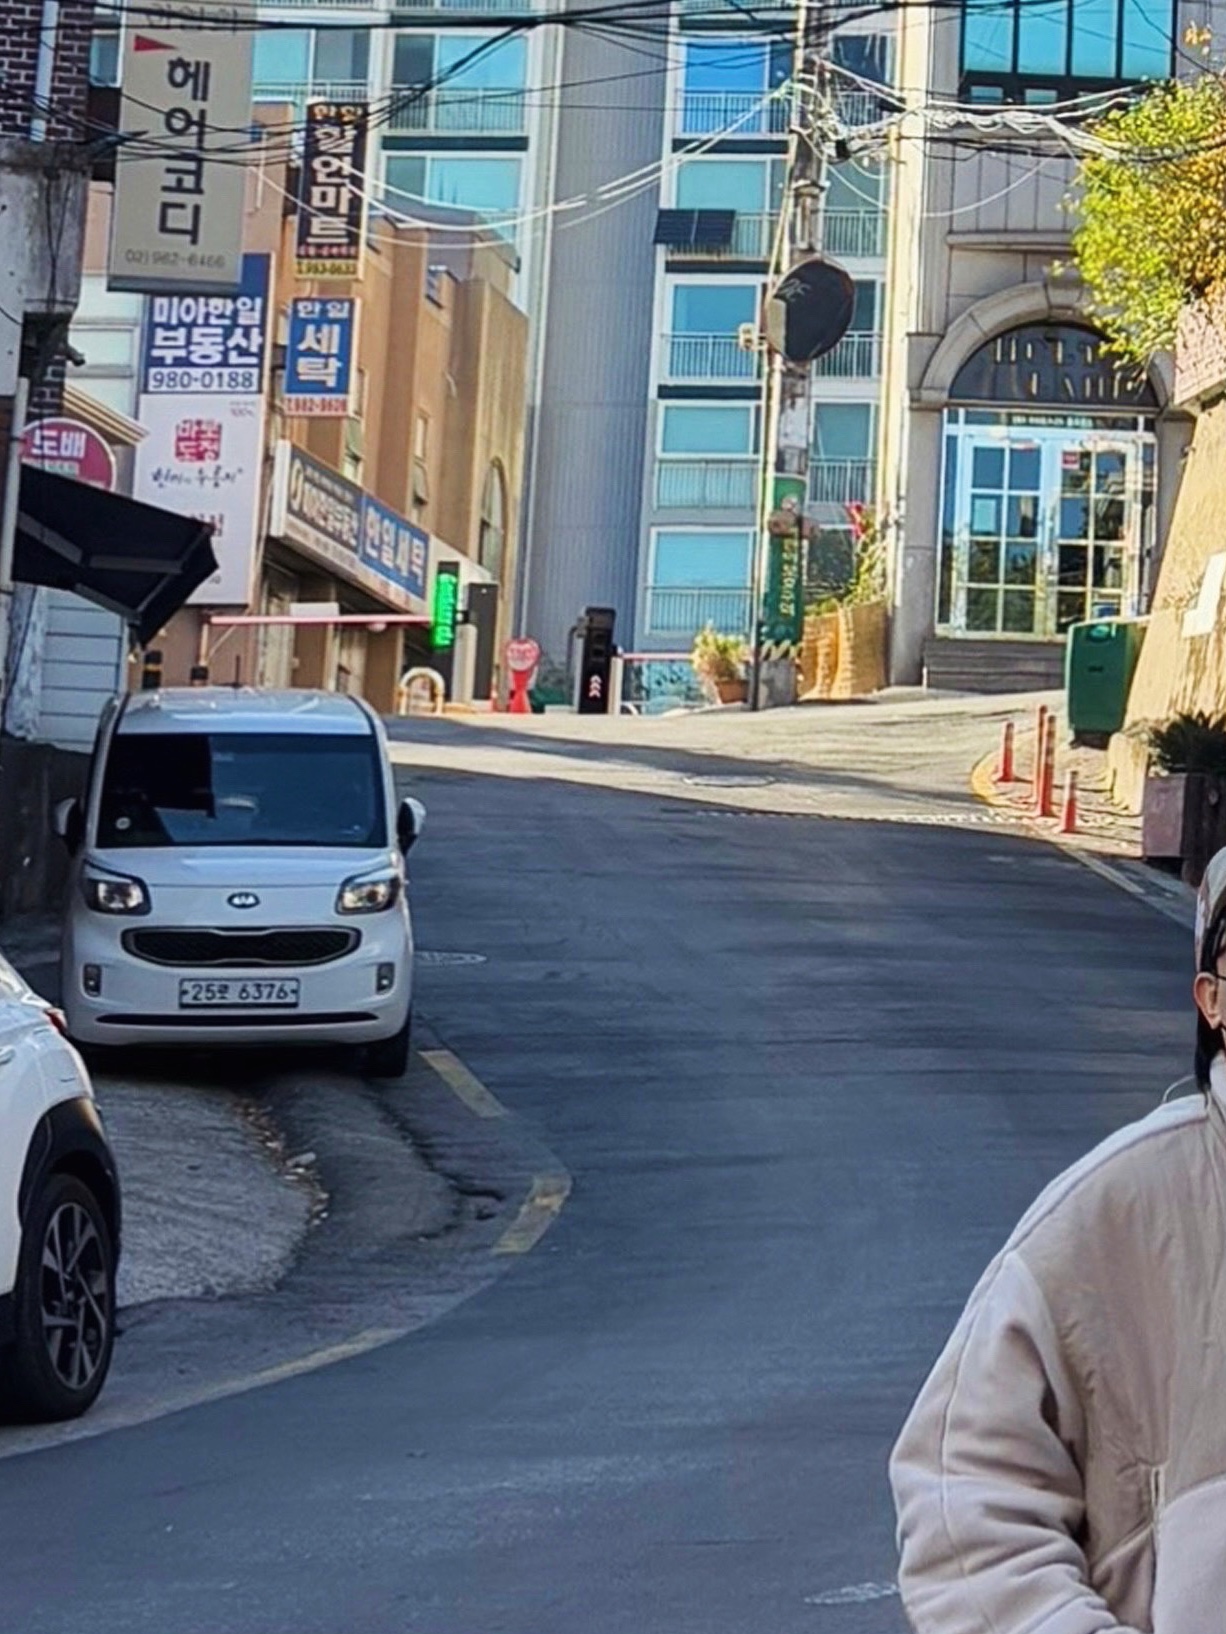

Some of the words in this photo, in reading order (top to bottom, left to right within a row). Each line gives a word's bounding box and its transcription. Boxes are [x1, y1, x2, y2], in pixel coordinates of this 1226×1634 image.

[153, 297, 263, 325] 미아한일
[297, 301, 350, 318] 한일
[150, 327, 263, 365] 부동산
[296, 324, 343, 388] 세탁
[152, 370, 254, 389] 980-0188
[238, 982, 289, 1001] 6376
